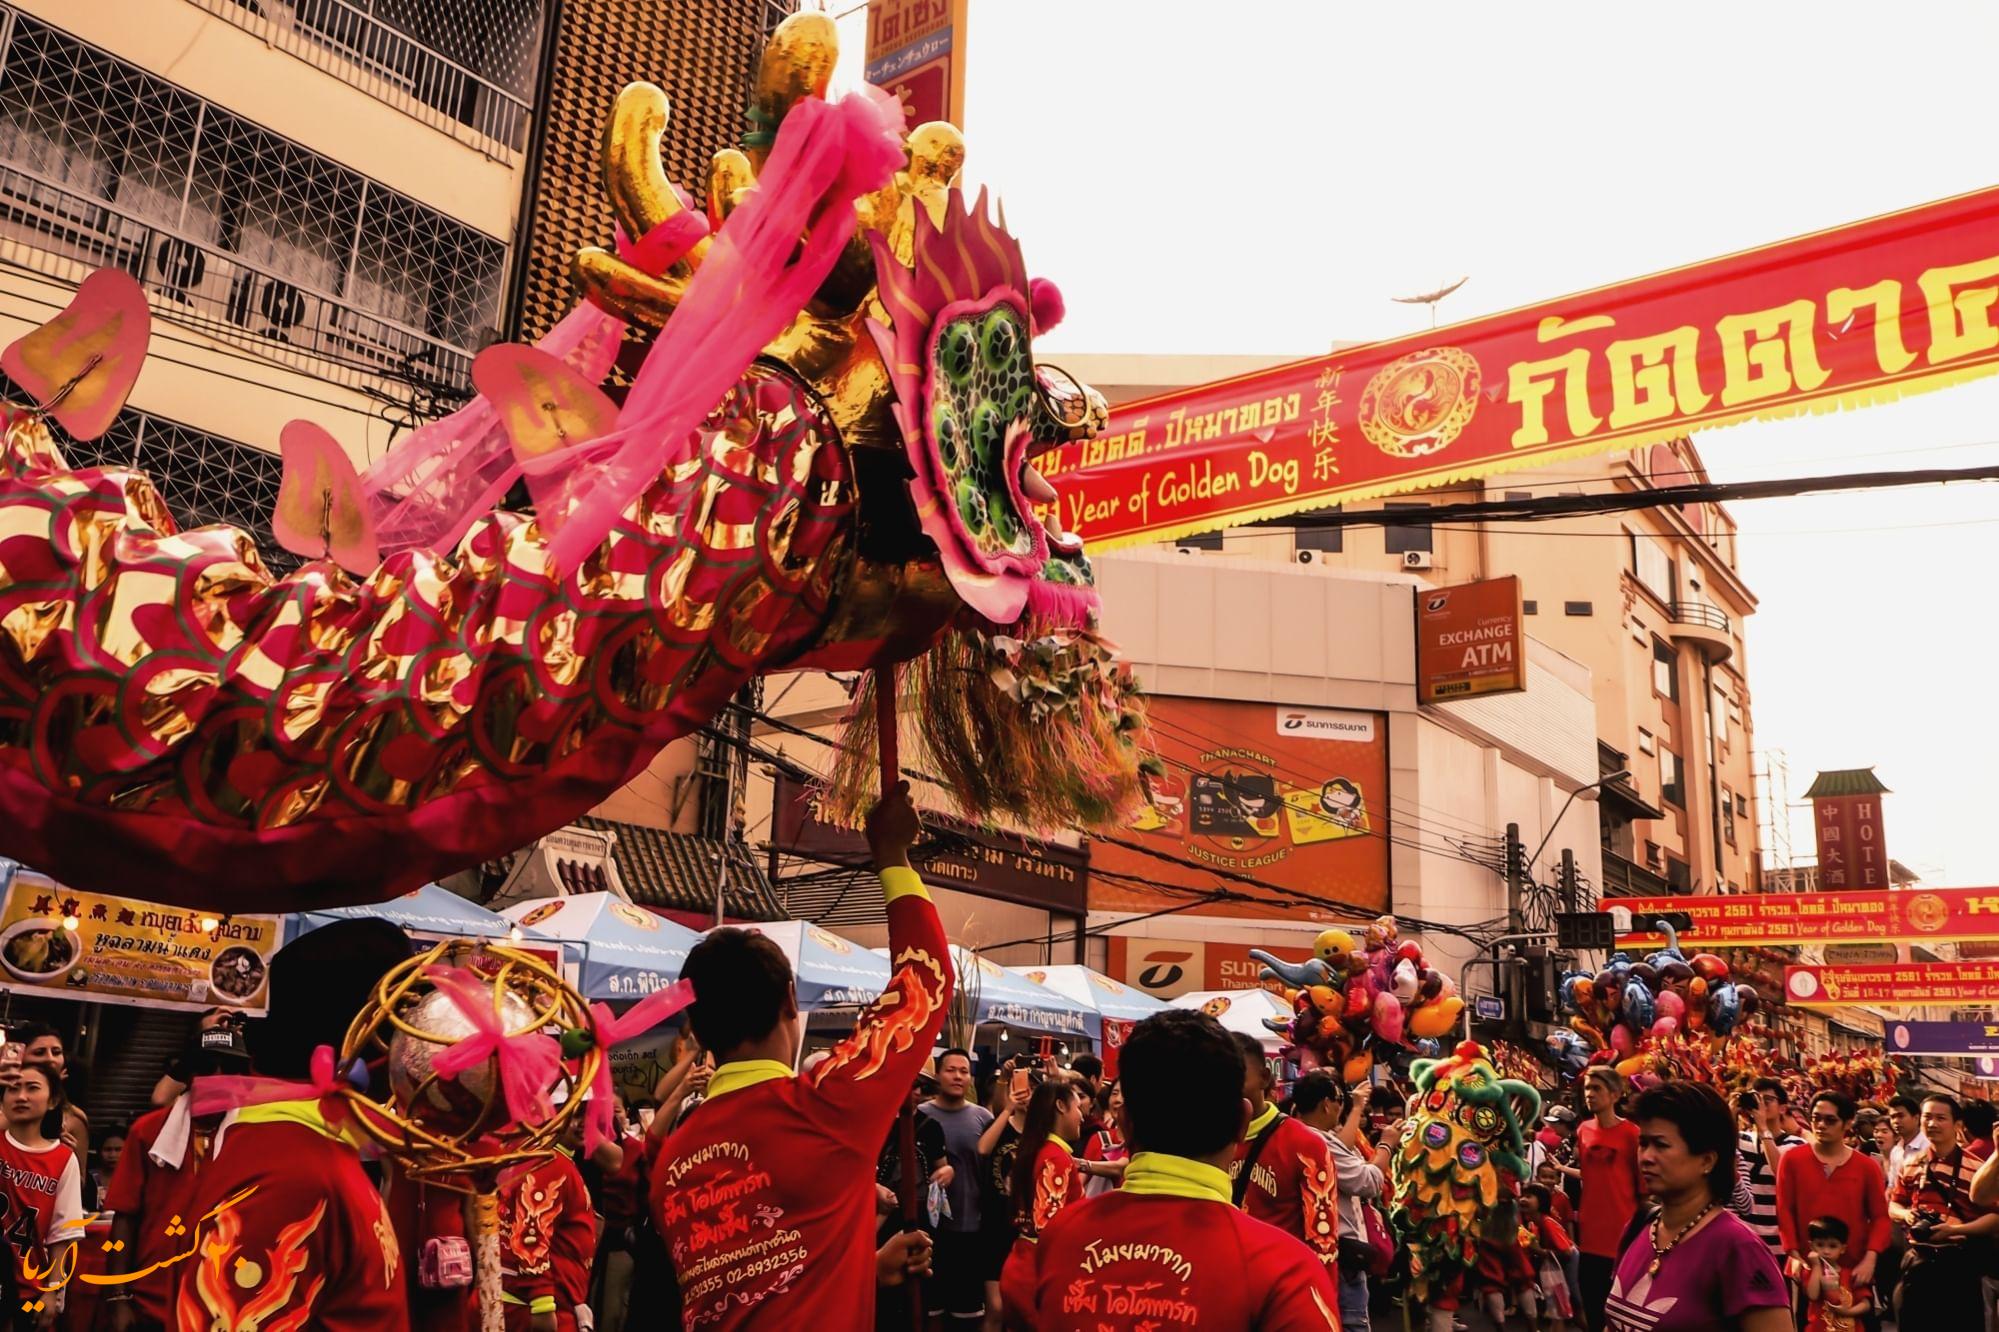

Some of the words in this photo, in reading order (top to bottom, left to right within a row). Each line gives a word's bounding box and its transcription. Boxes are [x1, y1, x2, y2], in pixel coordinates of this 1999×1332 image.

[1307, 365, 1344, 482] 新年快乐
[1069, 490, 1119, 532] Year
[1128, 473, 1151, 525] of
[1158, 460, 1240, 507] Golden
[1248, 450, 1299, 495] Dog
[1440, 624, 1512, 646] EXCHANGE
[1461, 641, 1512, 668] ATM
[1199, 748, 1277, 768] THANACHART
[1188, 845, 1236, 868] JUSTICE
[1241, 848, 1287, 868] LEAGUE
[1821, 921, 1830, 936] of
[1832, 921, 1864, 934] Golden
[1867, 920, 1886, 936] Dog
[727, 1246, 808, 1284] 02-8932356
[1080, 1238, 1192, 1282] ขโมยมาจาก
